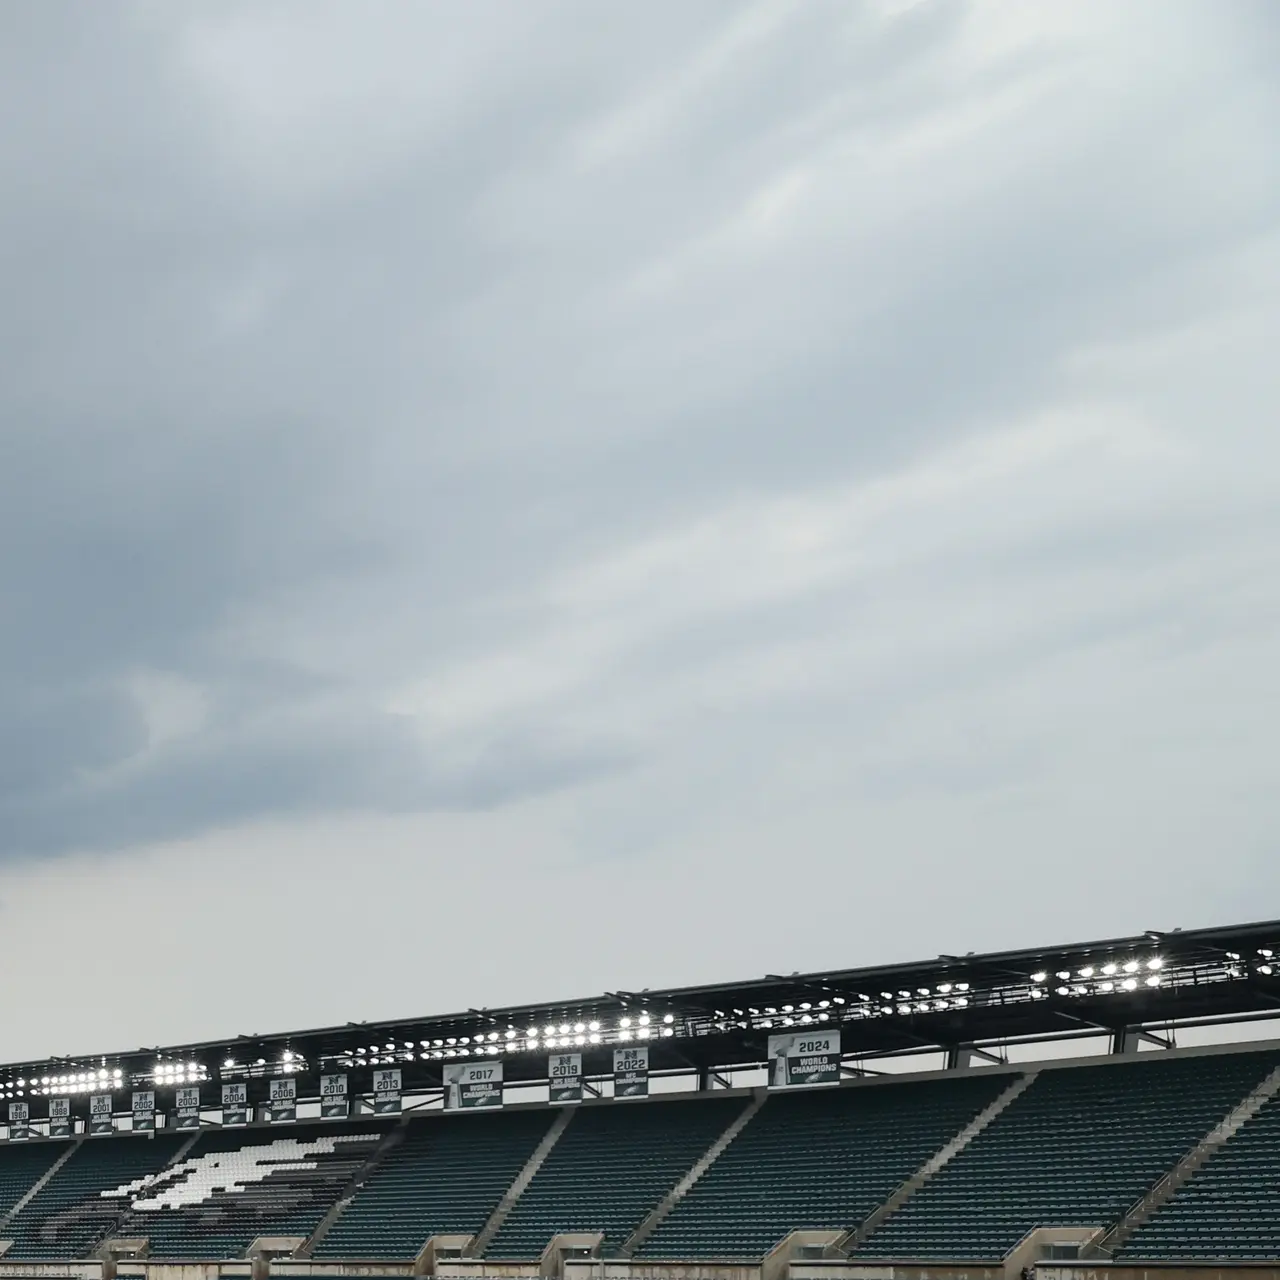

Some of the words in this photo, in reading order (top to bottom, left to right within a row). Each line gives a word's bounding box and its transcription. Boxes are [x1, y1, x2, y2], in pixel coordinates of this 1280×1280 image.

[799, 1040, 830, 1053] 2024
[616, 1059, 646, 1071] 2022
[800, 1056, 828, 1066] WORLD
[552, 1065, 578, 1076] 2019
[791, 1063, 837, 1075] CHAMPIONS
[469, 1069, 494, 1081] 2017
[323, 1085, 344, 1095] 2010
[377, 1080, 399, 1090] 2013
[469, 1083, 493, 1092] WORLD
[224, 1093, 245, 1103] 2004
[272, 1089, 294, 1099] 2006
[462, 1088, 501, 1098] CHAMPIONS
[134, 1100, 153, 1110] 2002
[178, 1097, 198, 1107] 2003
[93, 1103, 110, 1112] 2001
[11, 1110, 27, 1119] 1980
